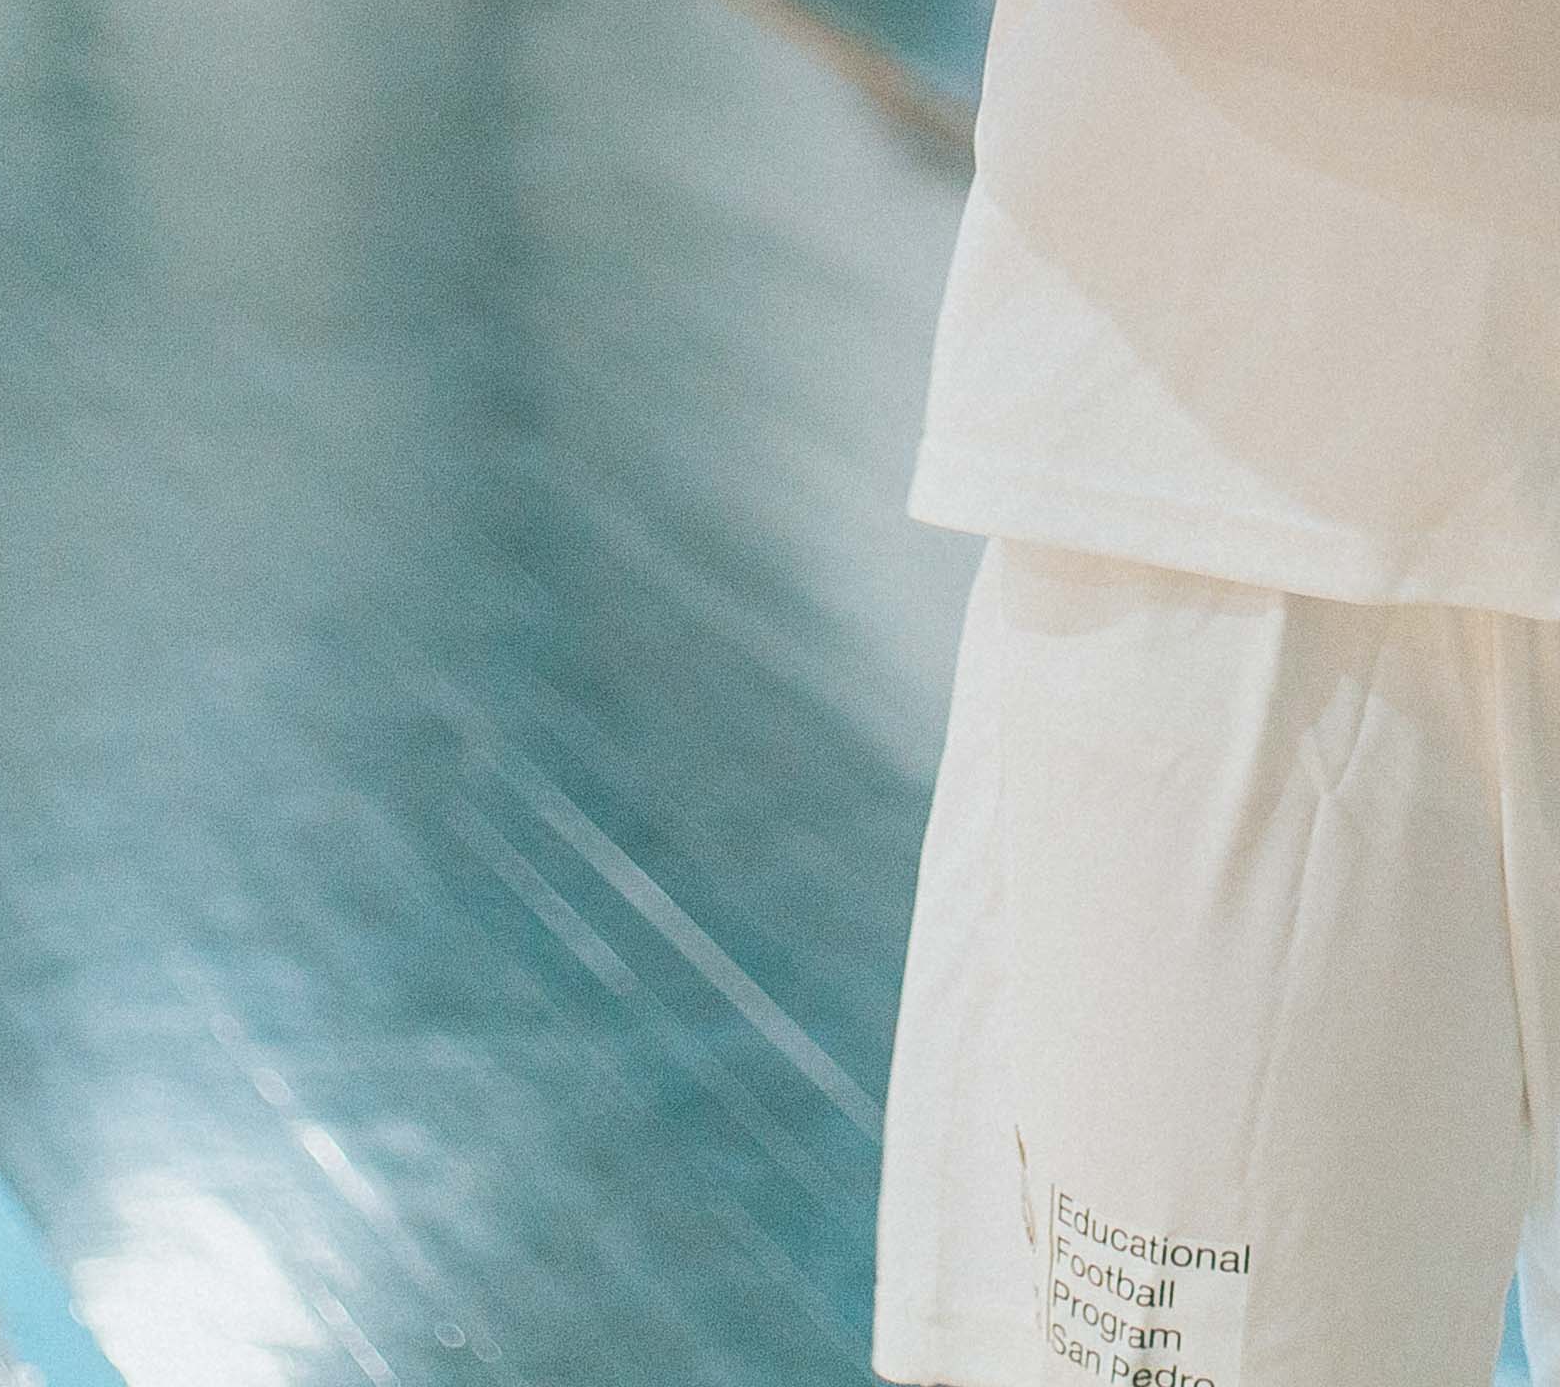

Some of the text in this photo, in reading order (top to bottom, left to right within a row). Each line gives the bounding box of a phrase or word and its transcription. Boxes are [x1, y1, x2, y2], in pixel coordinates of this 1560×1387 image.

[1058, 1193, 1250, 1275] Educational
[1056, 1236, 1175, 1309] Football
[1052, 1323, 1101, 1375] San
[1053, 1280, 1182, 1351] Program
